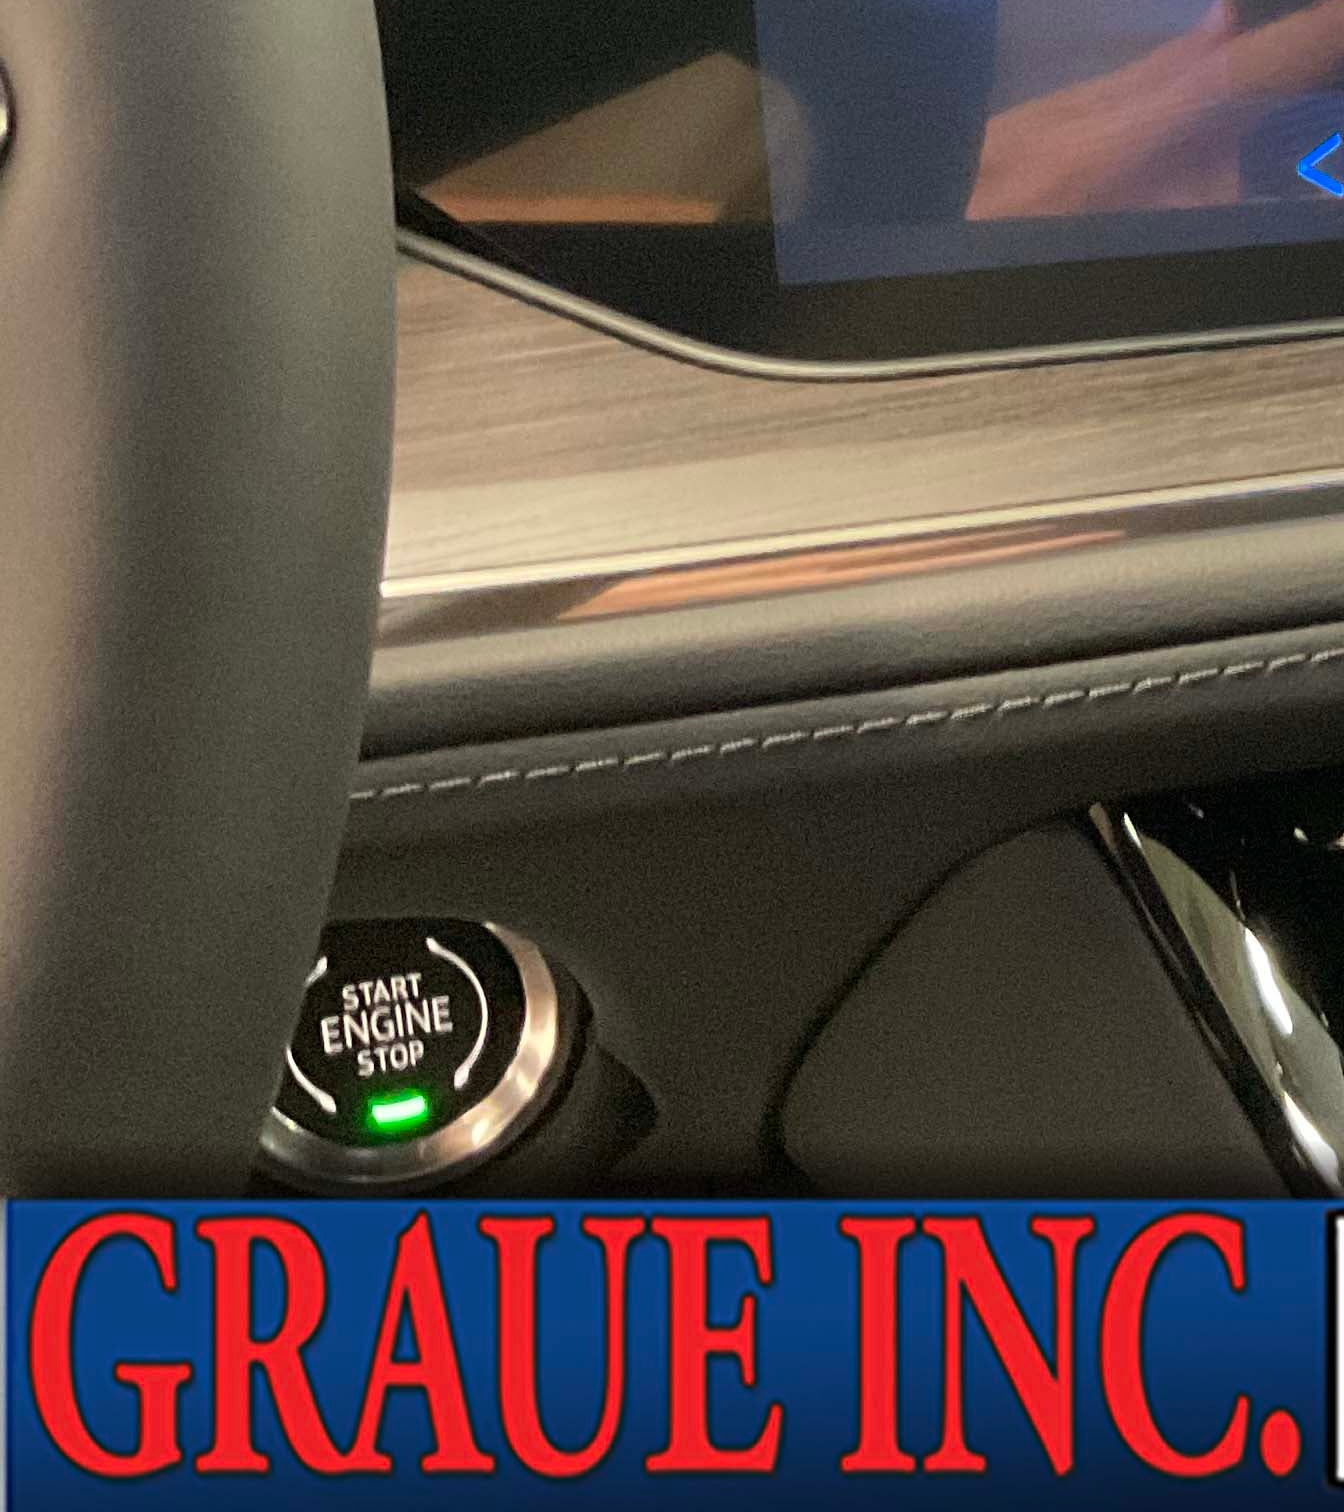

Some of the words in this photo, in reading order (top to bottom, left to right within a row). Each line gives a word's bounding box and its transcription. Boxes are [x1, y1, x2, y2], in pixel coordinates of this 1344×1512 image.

[341, 972, 423, 1012] START
[320, 995, 454, 1055] ENGINE
[356, 1039, 425, 1078] STOP
